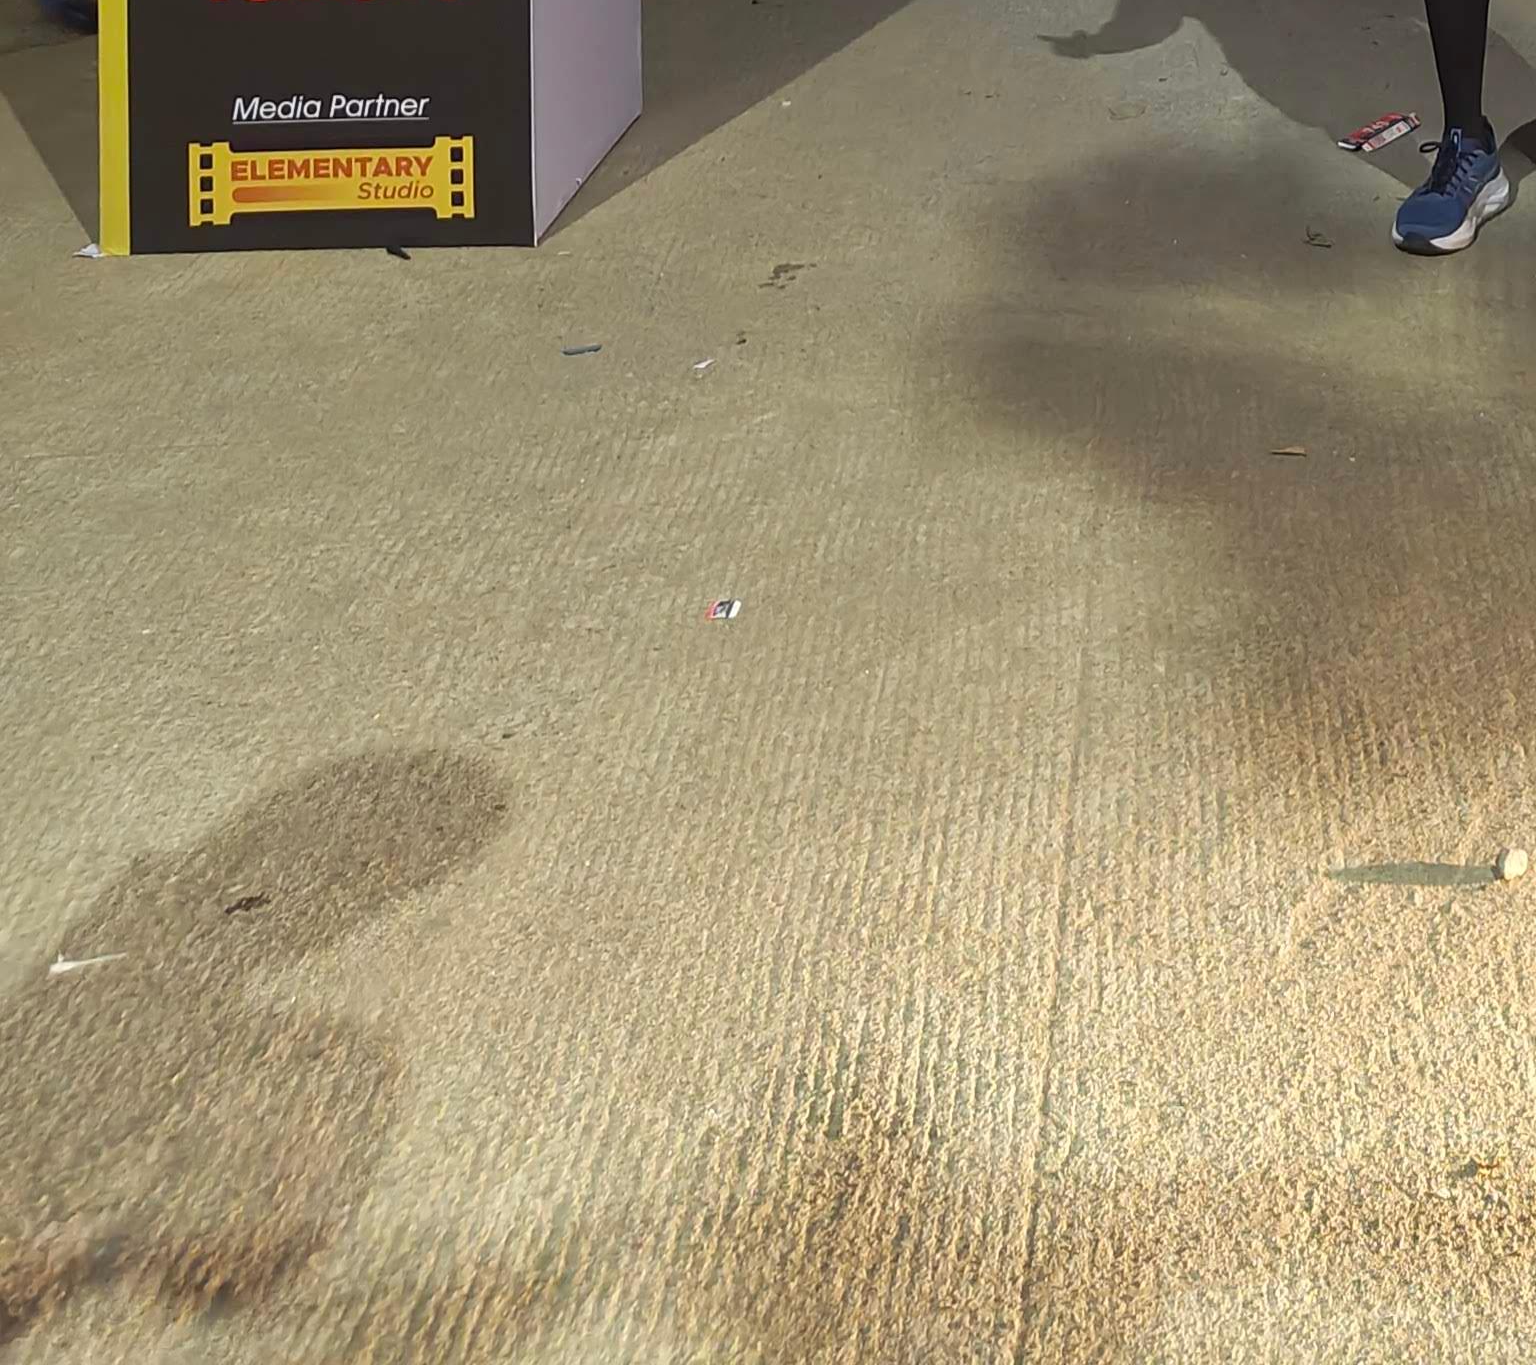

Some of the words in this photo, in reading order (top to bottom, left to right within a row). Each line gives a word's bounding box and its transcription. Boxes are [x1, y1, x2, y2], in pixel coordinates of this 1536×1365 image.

[232, 96, 321, 121] Media
[329, 94, 429, 118] Partner
[230, 156, 433, 181] ELEMENTARY
[357, 181, 434, 200] Studio
